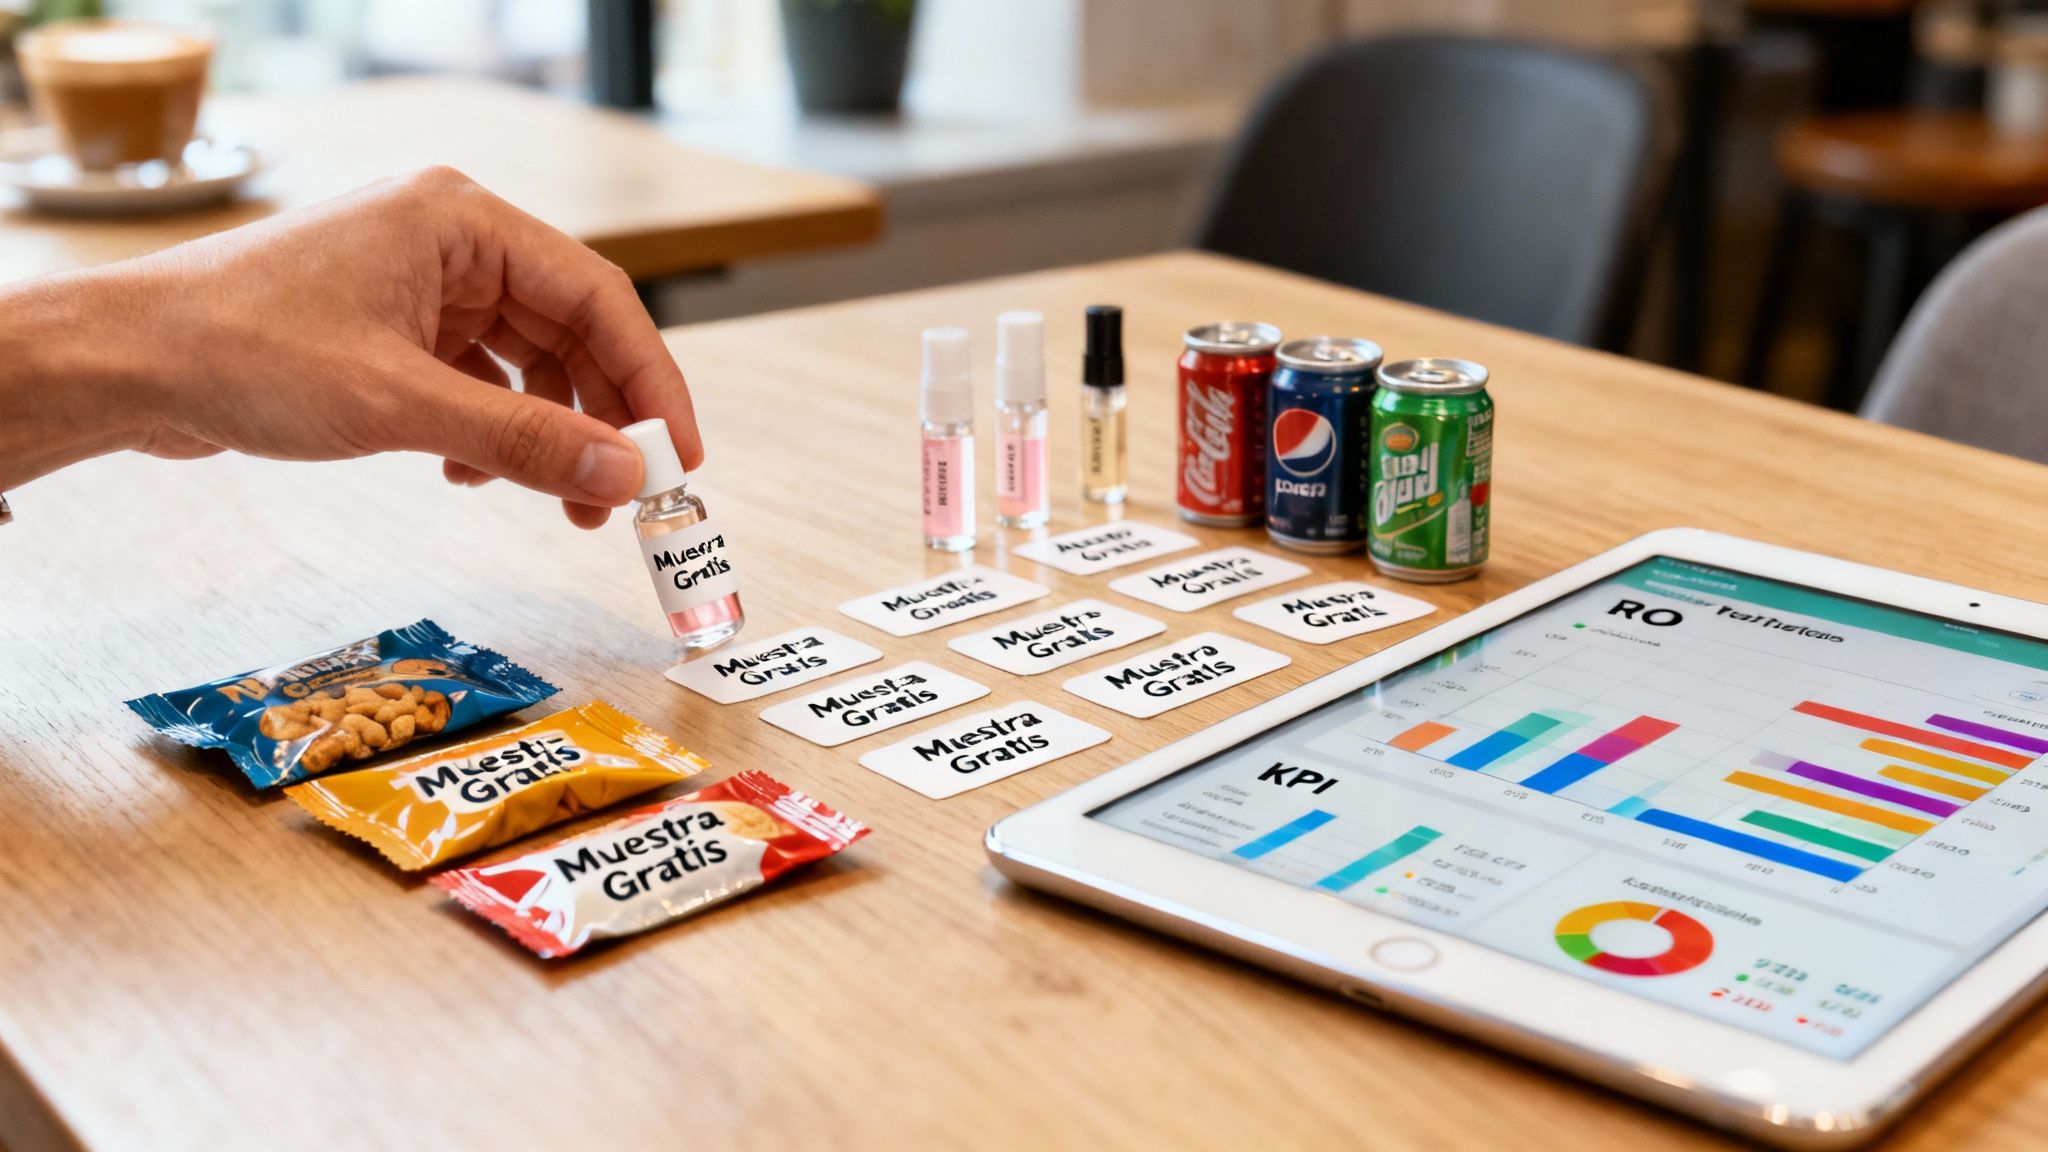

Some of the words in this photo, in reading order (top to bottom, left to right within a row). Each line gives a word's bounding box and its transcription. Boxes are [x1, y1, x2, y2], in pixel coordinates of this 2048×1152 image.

[1258, 762, 1339, 795] KPI
[554, 810, 724, 882] Muestra
[603, 838, 727, 900] Gratis
